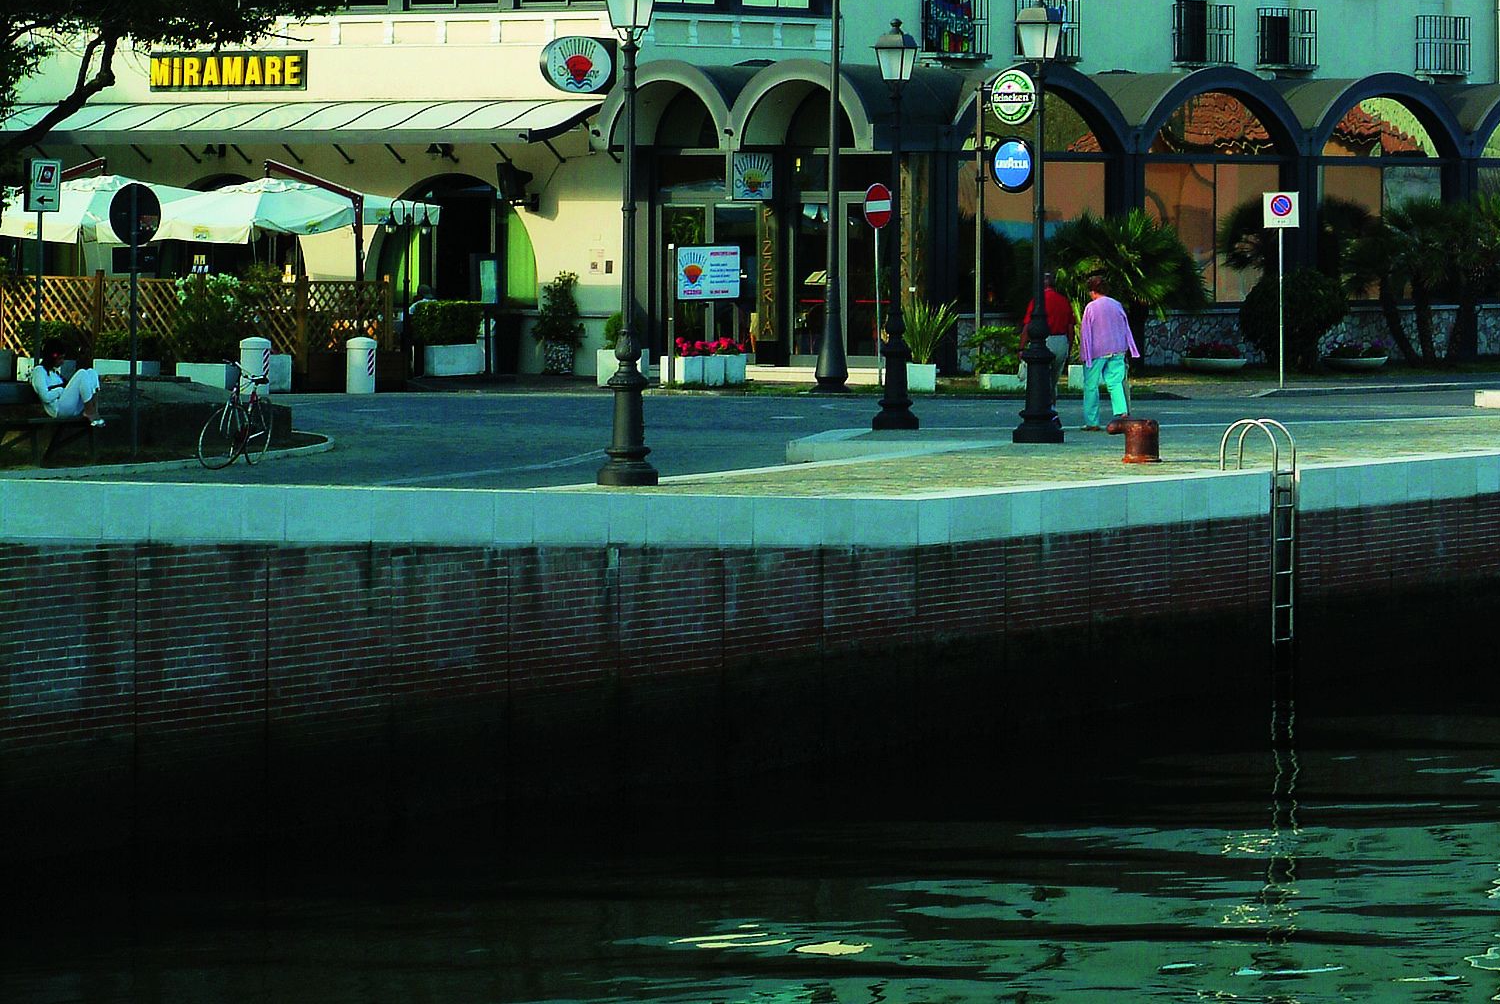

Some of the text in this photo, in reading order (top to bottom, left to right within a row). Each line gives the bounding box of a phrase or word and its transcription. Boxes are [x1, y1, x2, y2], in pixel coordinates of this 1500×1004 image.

[150, 54, 300, 87] MIRAMARE
[993, 93, 1029, 102] Heineken
[761, 207, 774, 336] PIZZERIA
